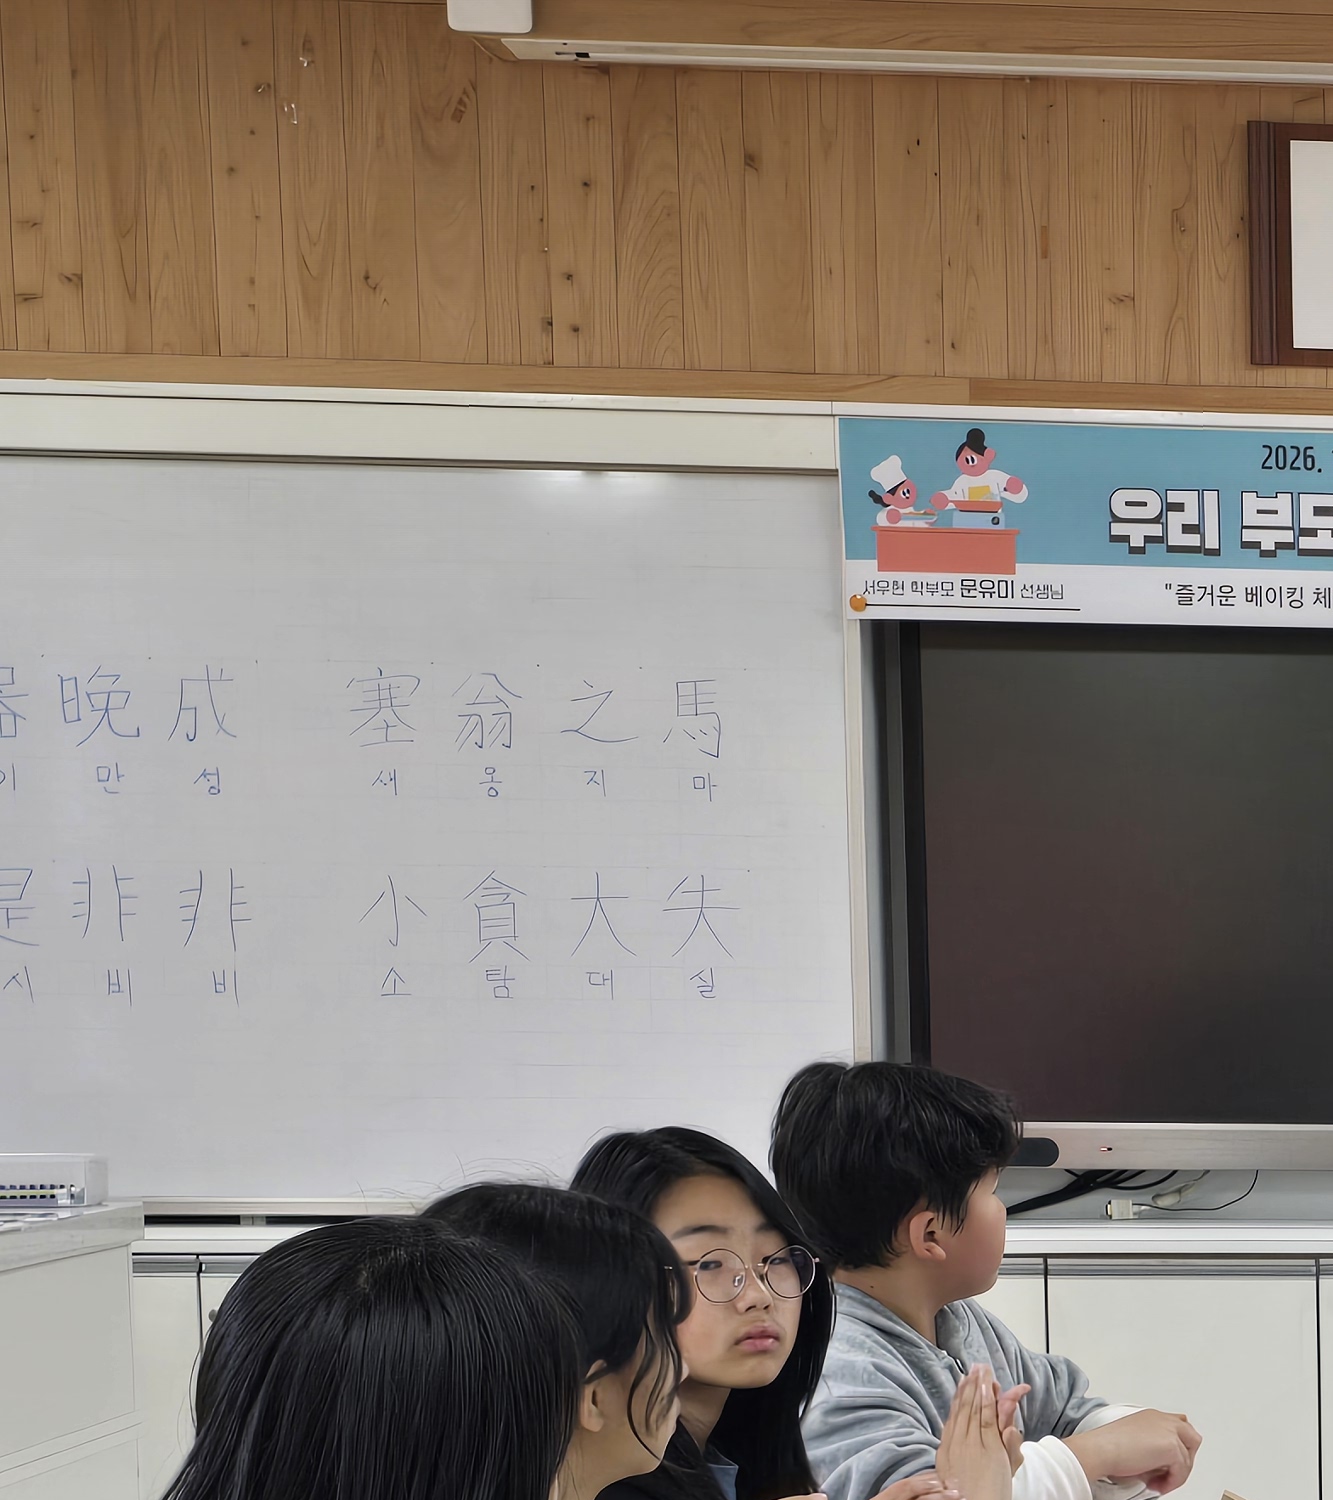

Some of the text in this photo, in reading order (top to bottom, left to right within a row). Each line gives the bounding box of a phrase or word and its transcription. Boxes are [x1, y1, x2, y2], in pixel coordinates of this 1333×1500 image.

[1260, 444, 1322, 474] 2026.
[1109, 486, 1221, 557] 우리
[960, 578, 1014, 599] 문유미
[1020, 583, 1064, 600] 선생님
[1244, 585, 1304, 609] 베이킹
